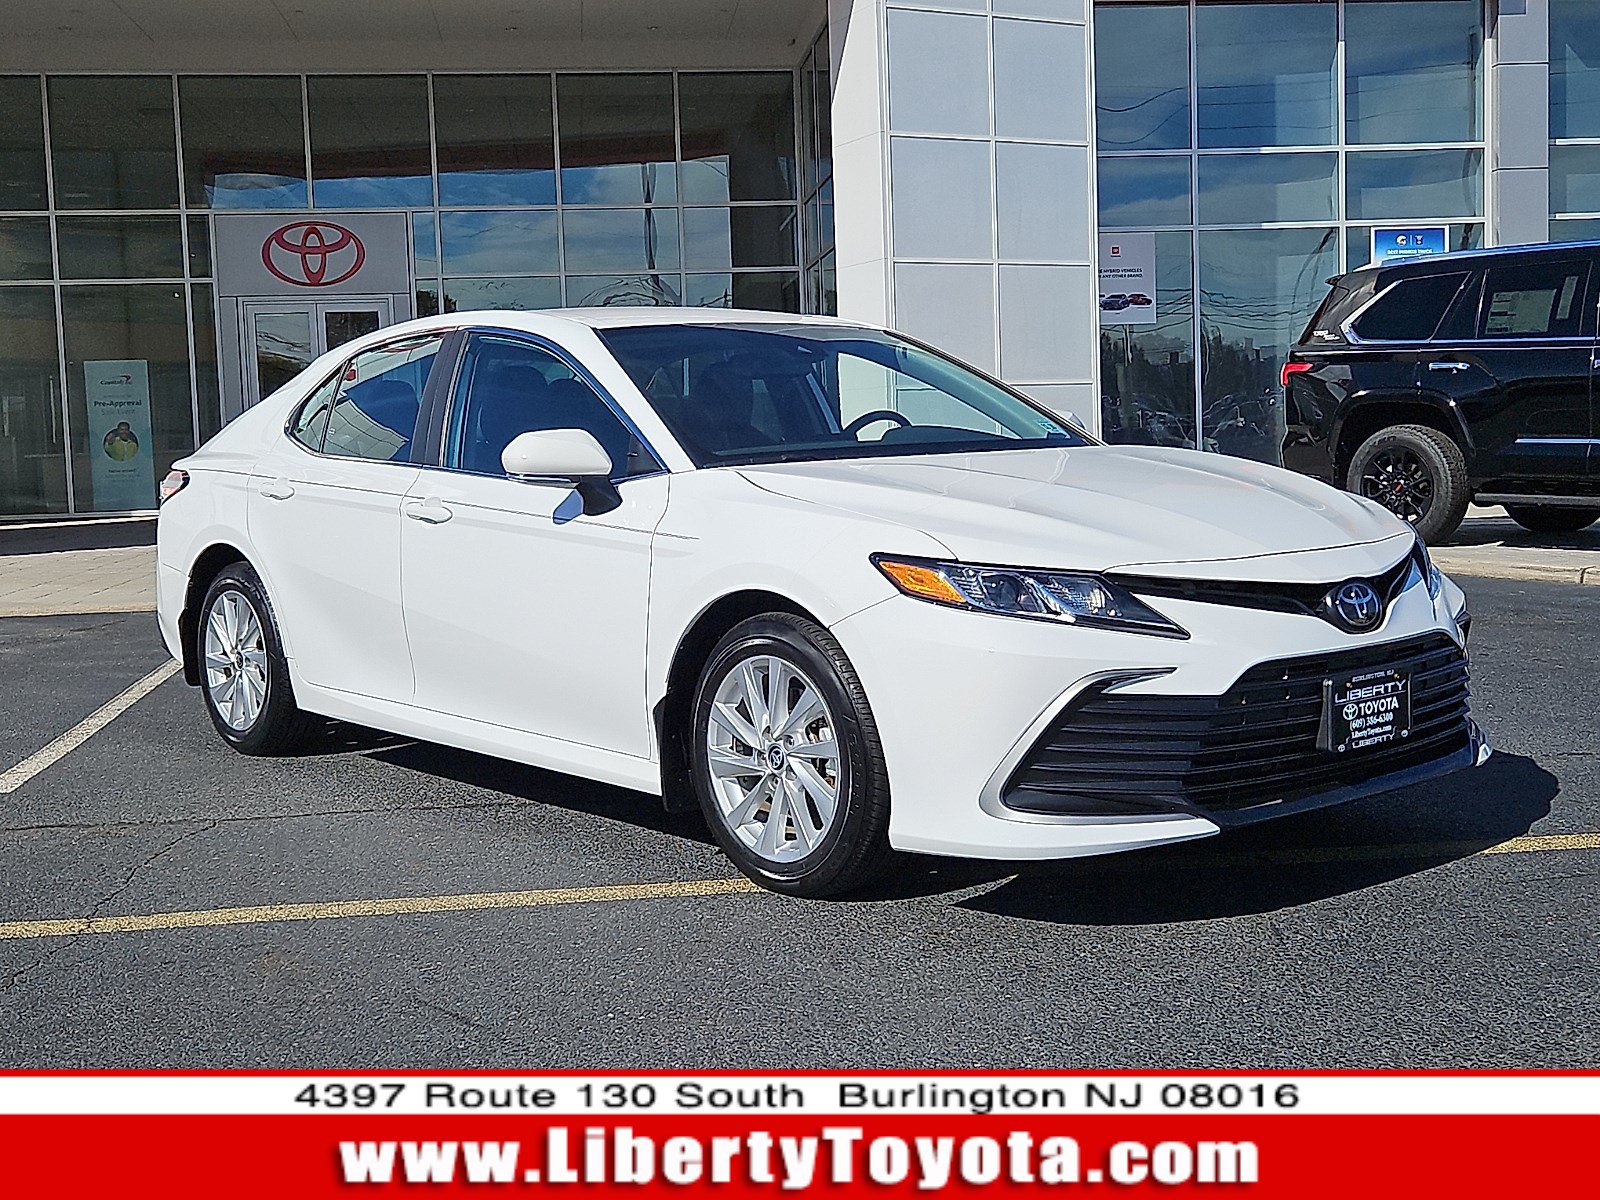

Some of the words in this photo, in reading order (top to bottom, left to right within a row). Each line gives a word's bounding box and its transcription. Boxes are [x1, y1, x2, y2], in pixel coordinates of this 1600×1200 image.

[93, 399, 142, 408] Pre-Approval
[1334, 679, 1406, 703] LIBERTY
[1359, 696, 1399, 716] TOYOTA
[1352, 733, 1395, 748] LIBERTY
